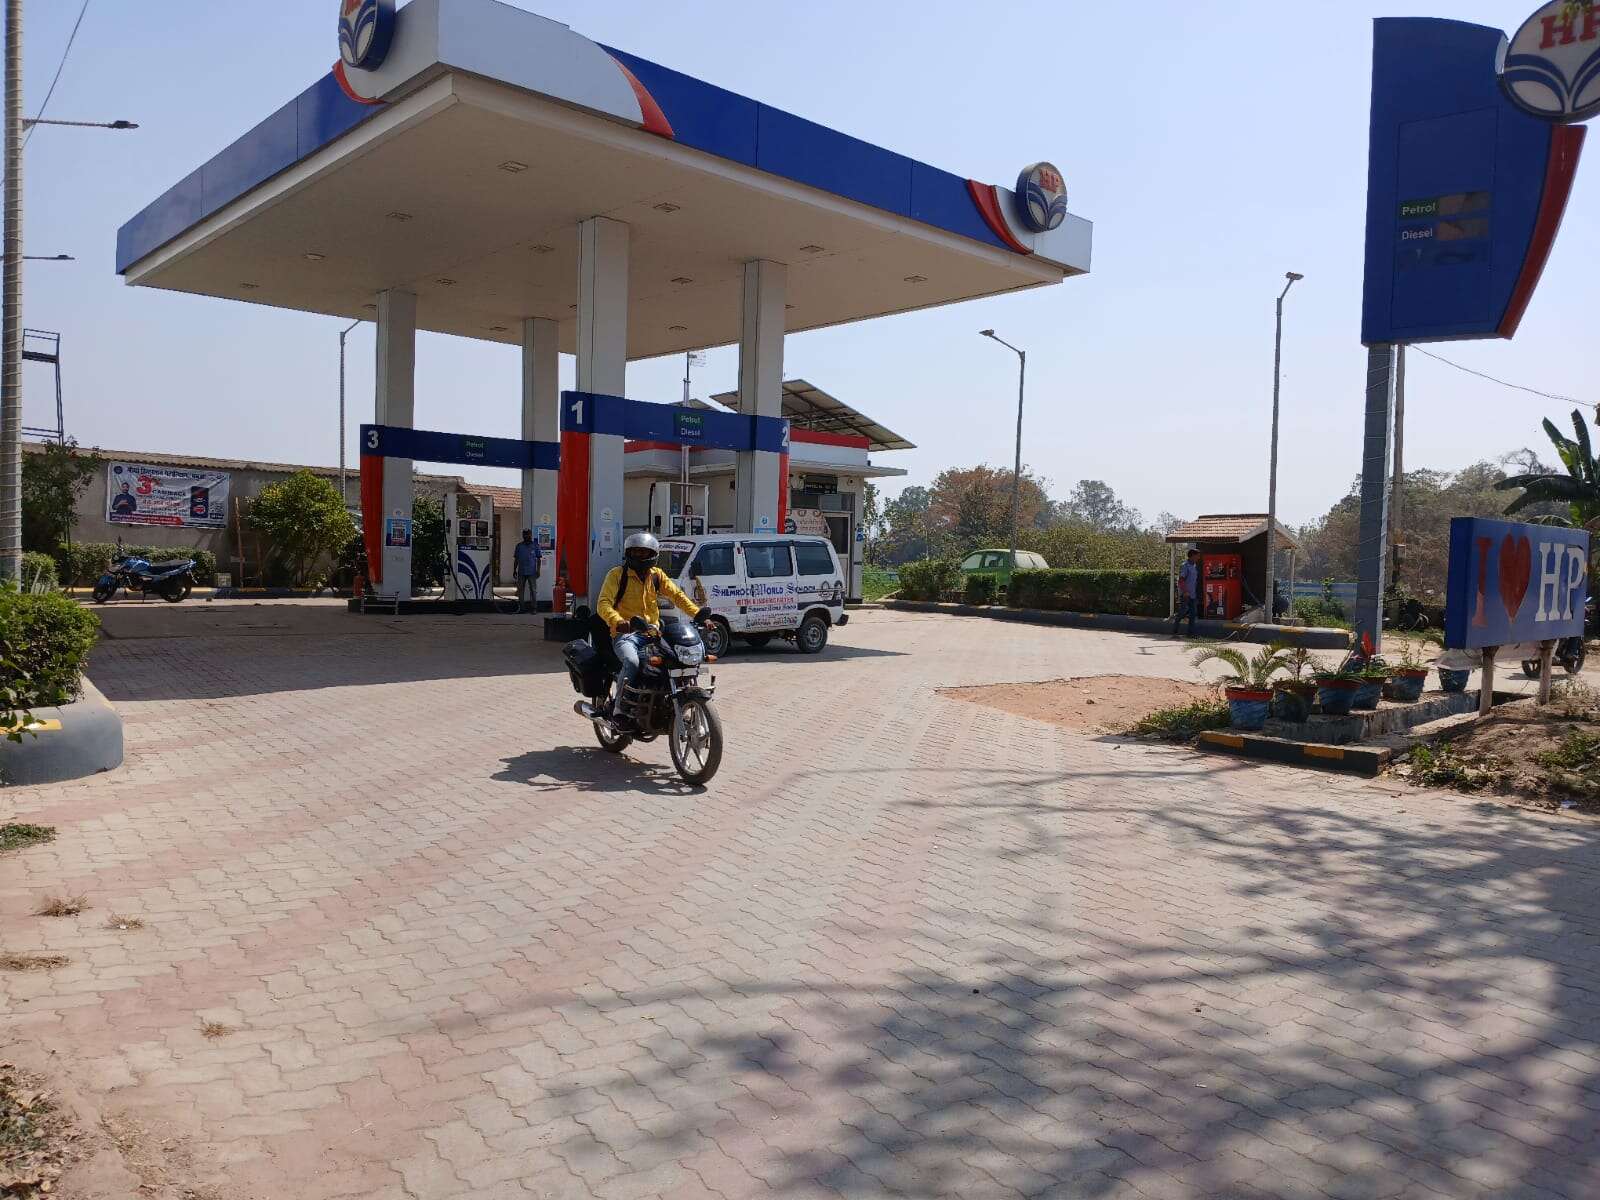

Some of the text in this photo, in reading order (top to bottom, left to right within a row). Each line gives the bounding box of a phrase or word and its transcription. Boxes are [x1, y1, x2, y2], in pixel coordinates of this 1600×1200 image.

[1402, 202, 1436, 216] Petrol
[1401, 227, 1433, 240] Diesel
[571, 400, 583, 425] 1
[367, 430, 379, 449] 3
[781, 426, 789, 447] 2
[1471, 537, 1585, 627] I HP
